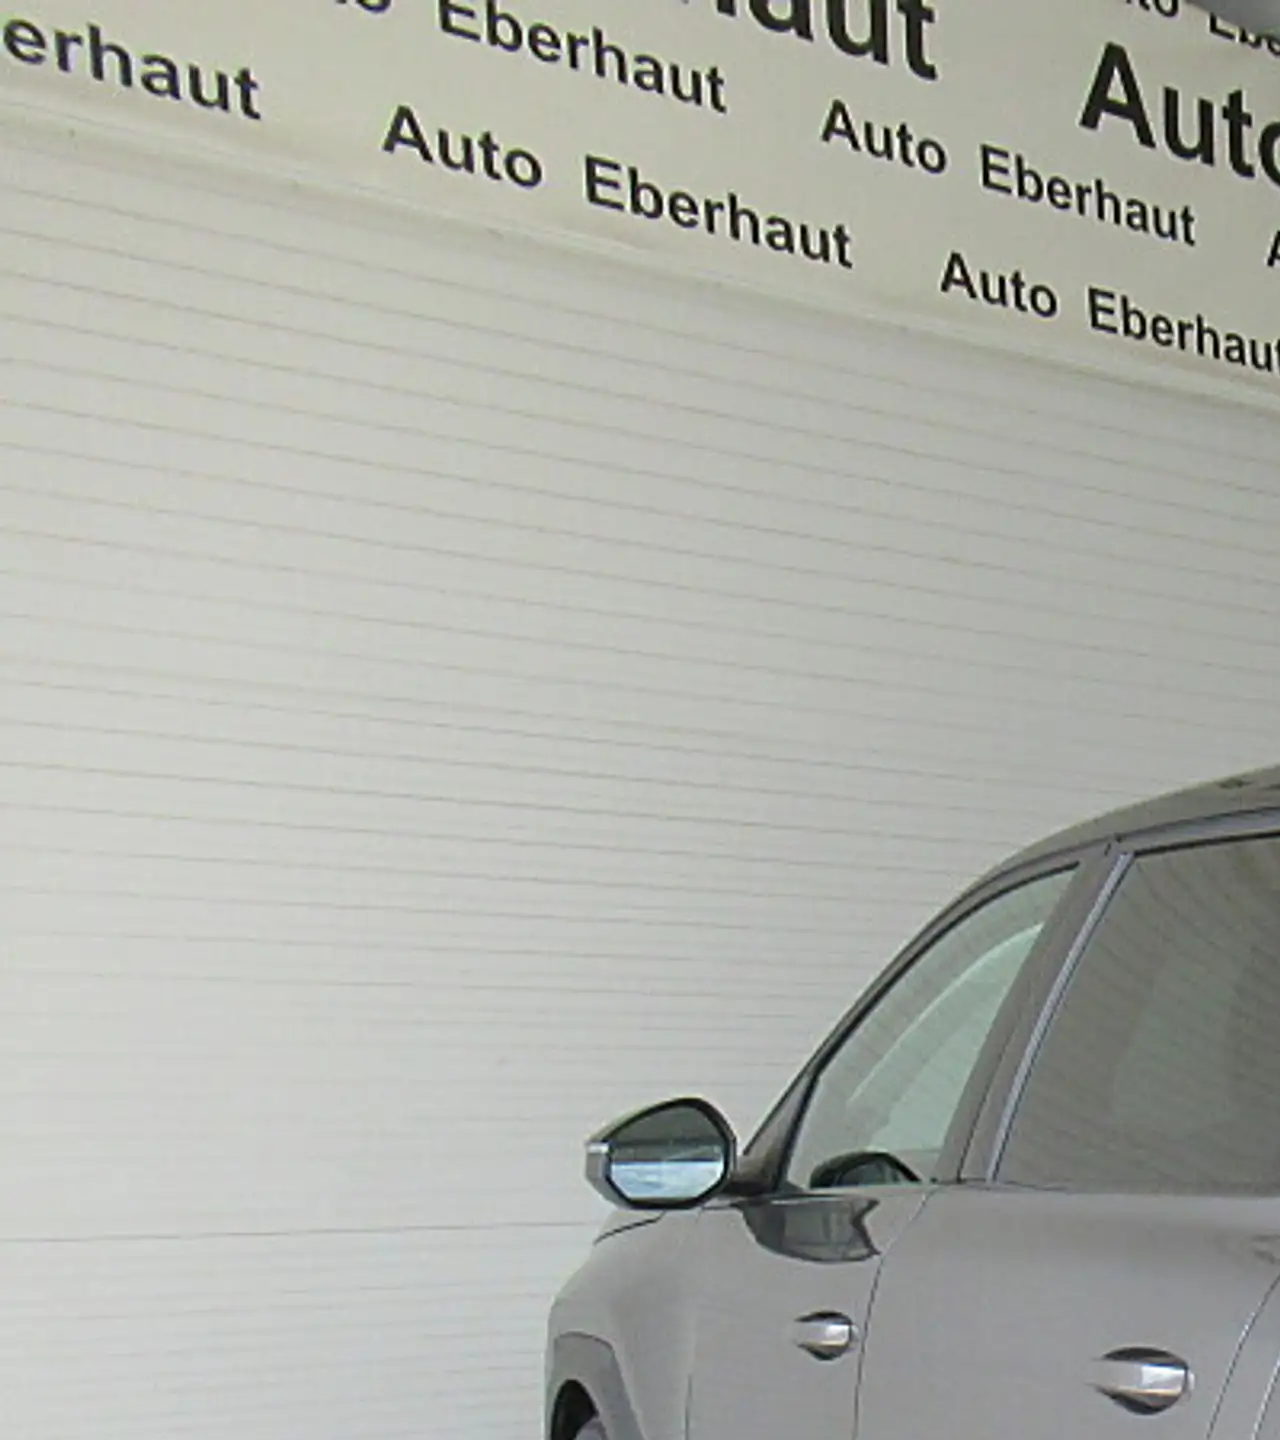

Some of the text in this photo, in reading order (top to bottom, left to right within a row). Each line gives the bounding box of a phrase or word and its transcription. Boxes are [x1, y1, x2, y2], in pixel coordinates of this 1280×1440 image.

[438, 0, 727, 114] Eberhaut
[383, 105, 853, 269] Auto Eberhaut
[821, 99, 1196, 247] Auto Eberhaut
[940, 251, 1058, 318] Auto
